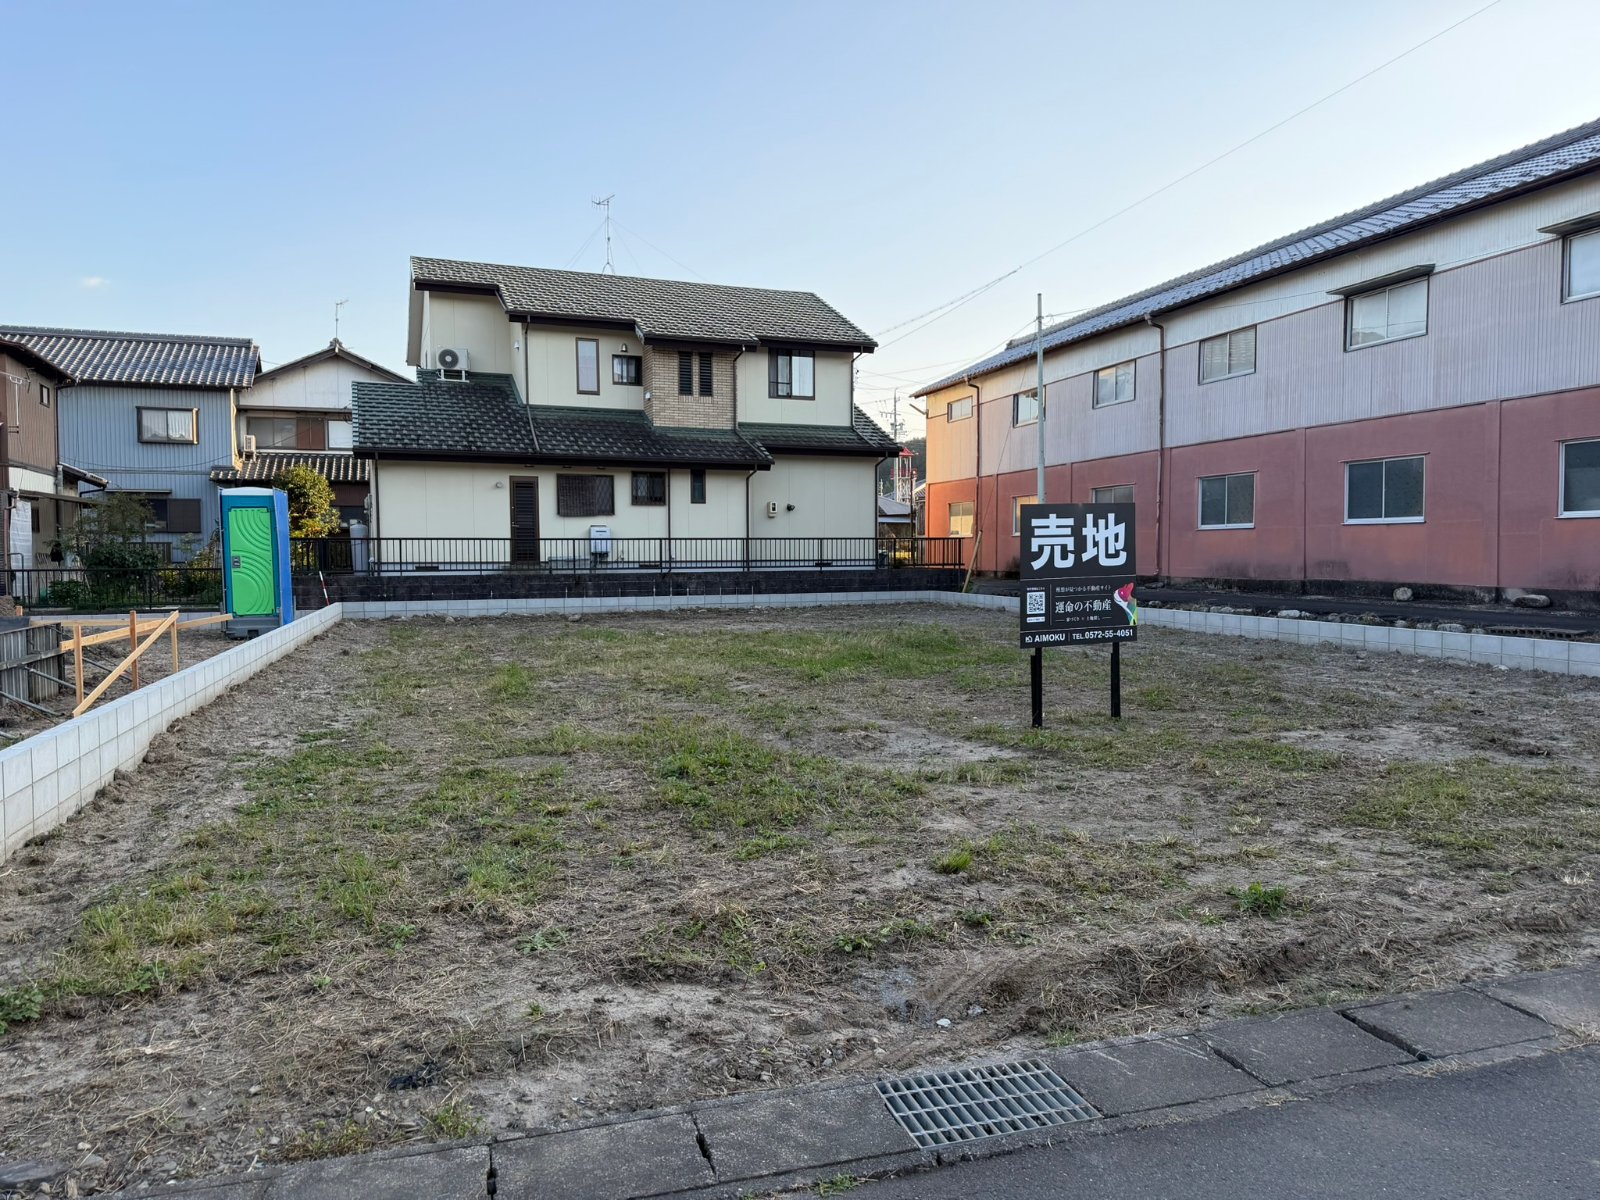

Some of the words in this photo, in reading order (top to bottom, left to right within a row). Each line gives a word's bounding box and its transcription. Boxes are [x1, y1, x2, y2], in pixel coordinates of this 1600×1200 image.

[1031, 513, 1127, 570] 売地
[1055, 599, 1112, 614] 運命の不動産
[1034, 633, 1066, 643] AIMOKU
[1072, 629, 1133, 640] TEL.0572-55-4051
